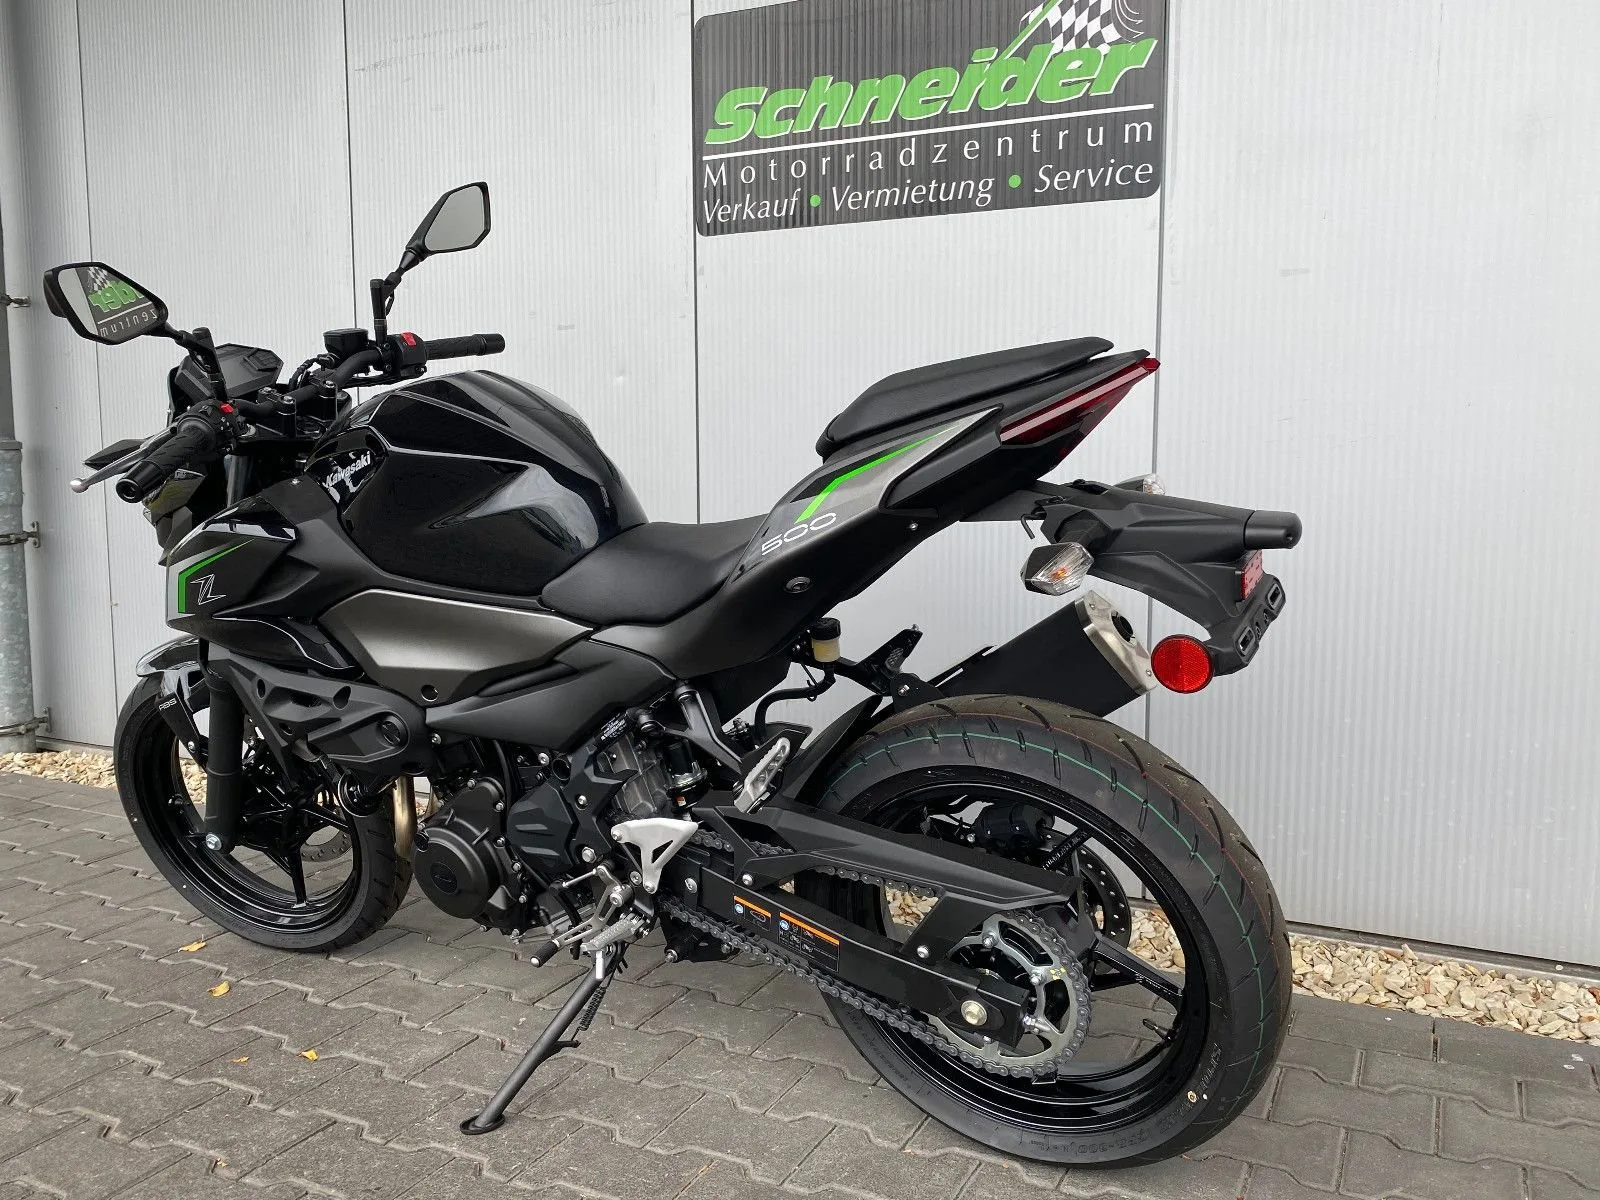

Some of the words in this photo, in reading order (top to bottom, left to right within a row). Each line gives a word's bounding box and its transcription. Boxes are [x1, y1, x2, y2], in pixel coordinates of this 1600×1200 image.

[704, 38, 1157, 145] Schneider
[703, 121, 1153, 188] Motorradzentrum
[703, 188, 799, 225] Verkauf
[831, 175, 994, 211] Vermietung
[1034, 159, 1153, 193] Service
[325, 450, 371, 487] Kawasaki
[761, 512, 837, 555] 500
[190, 573, 227, 605] Z
